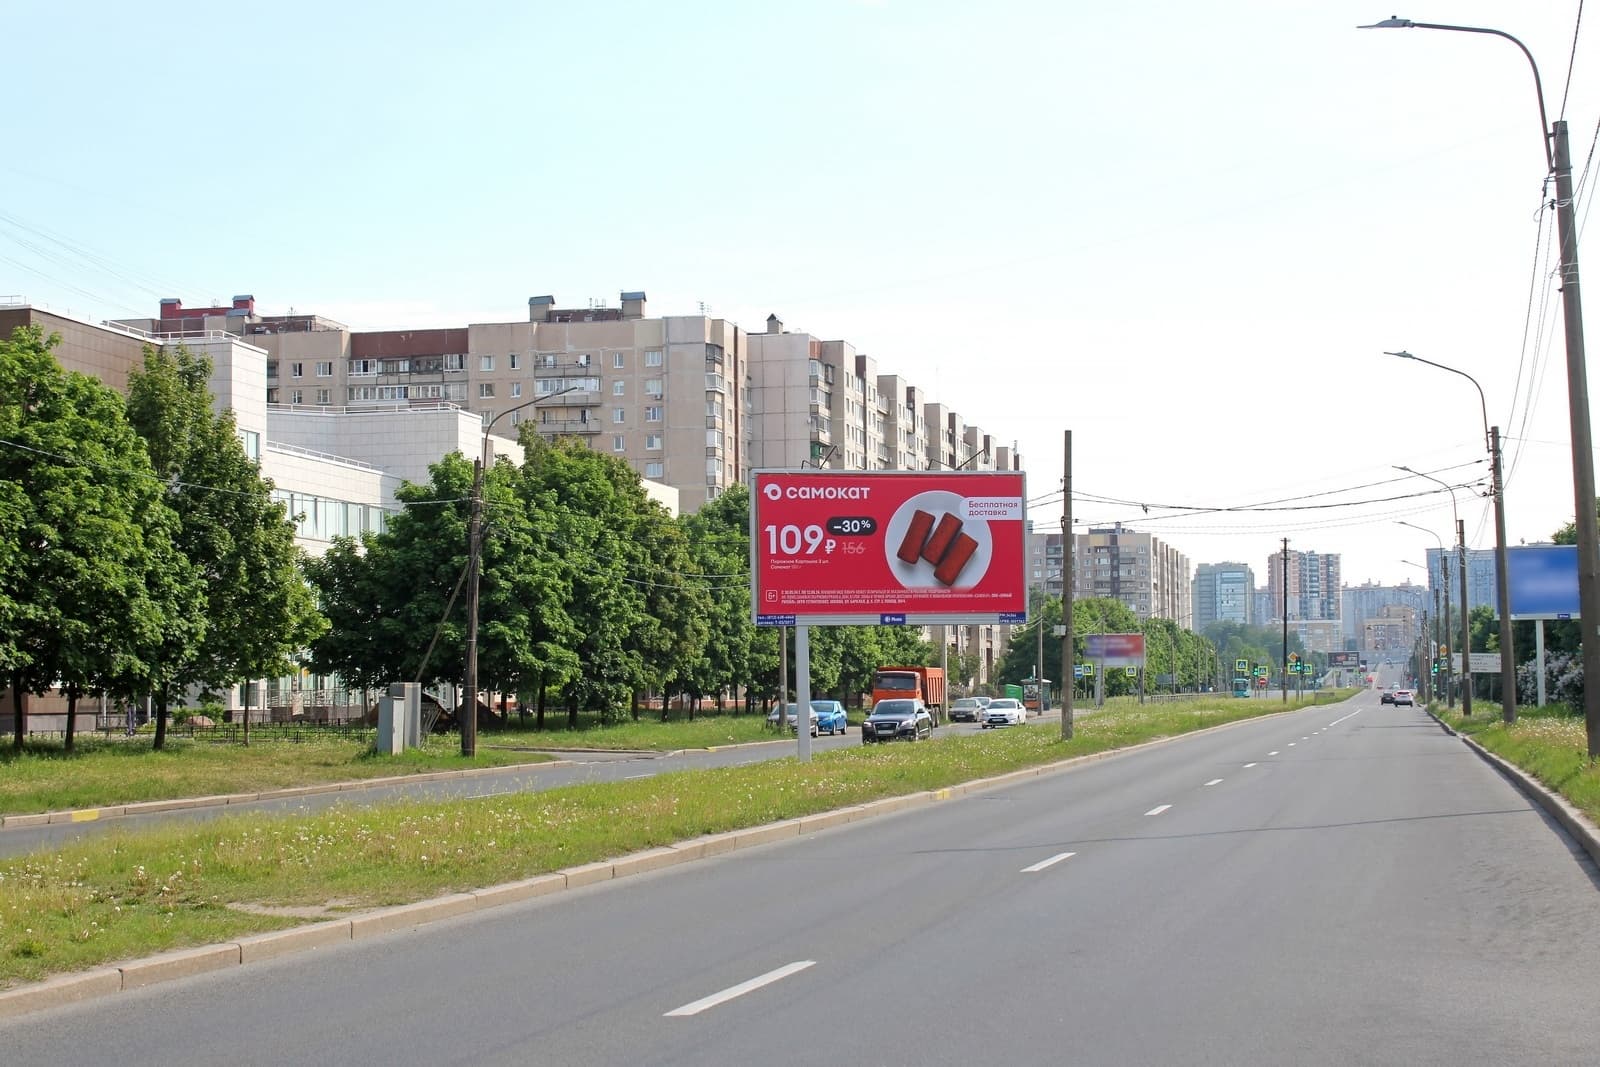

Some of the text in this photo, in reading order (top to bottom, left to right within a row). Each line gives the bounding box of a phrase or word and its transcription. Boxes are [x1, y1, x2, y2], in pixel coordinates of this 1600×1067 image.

[786, 486, 870, 499] самокат
[968, 500, 1018, 508] Бесплатная
[968, 509, 1007, 517] доставка
[842, 542, 866, 555] 156
